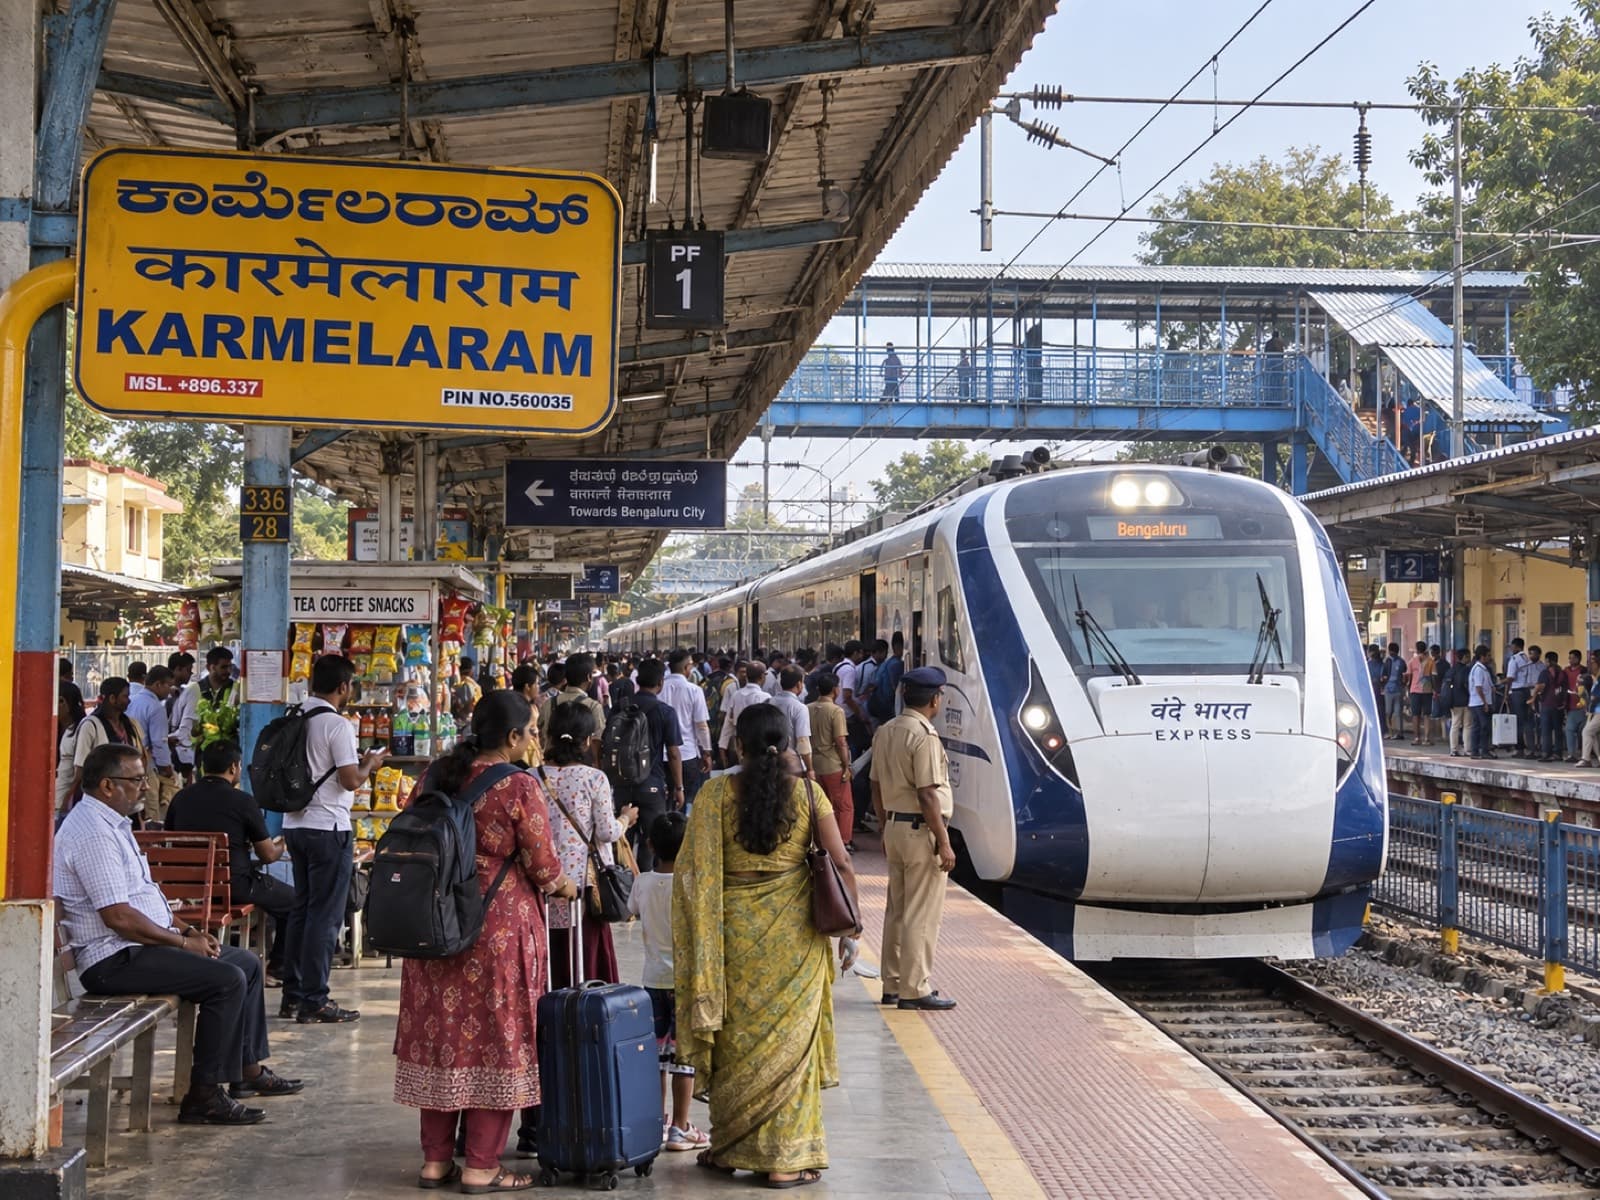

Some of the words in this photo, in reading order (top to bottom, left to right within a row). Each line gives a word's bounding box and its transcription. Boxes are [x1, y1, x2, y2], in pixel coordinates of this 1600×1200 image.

[671, 245, 701, 262] PF
[127, 238, 580, 311] कारमेलाराम
[675, 268, 692, 310] 1
[96, 308, 592, 377] KARMELARAM
[128, 375, 172, 391] MSL.
[178, 378, 259, 395] +896.337
[443, 390, 473, 405] PIN
[479, 392, 571, 410] NO.560035
[245, 488, 285, 511] 336
[569, 505, 618, 518] Towards
[621, 505, 679, 520] Bengaluru
[683, 505, 706, 521] City
[252, 516, 277, 538] 28
[1117, 521, 1188, 540] Bengaluru
[1404, 558, 1418, 576] 2
[294, 596, 316, 612] TEA
[320, 596, 364, 612] COFFEE
[368, 596, 415, 613] SNACKS
[1151, 696, 1186, 722] वंदे
[1194, 703, 1252, 720] भारत
[1155, 729, 1252, 741] EXPRESS
